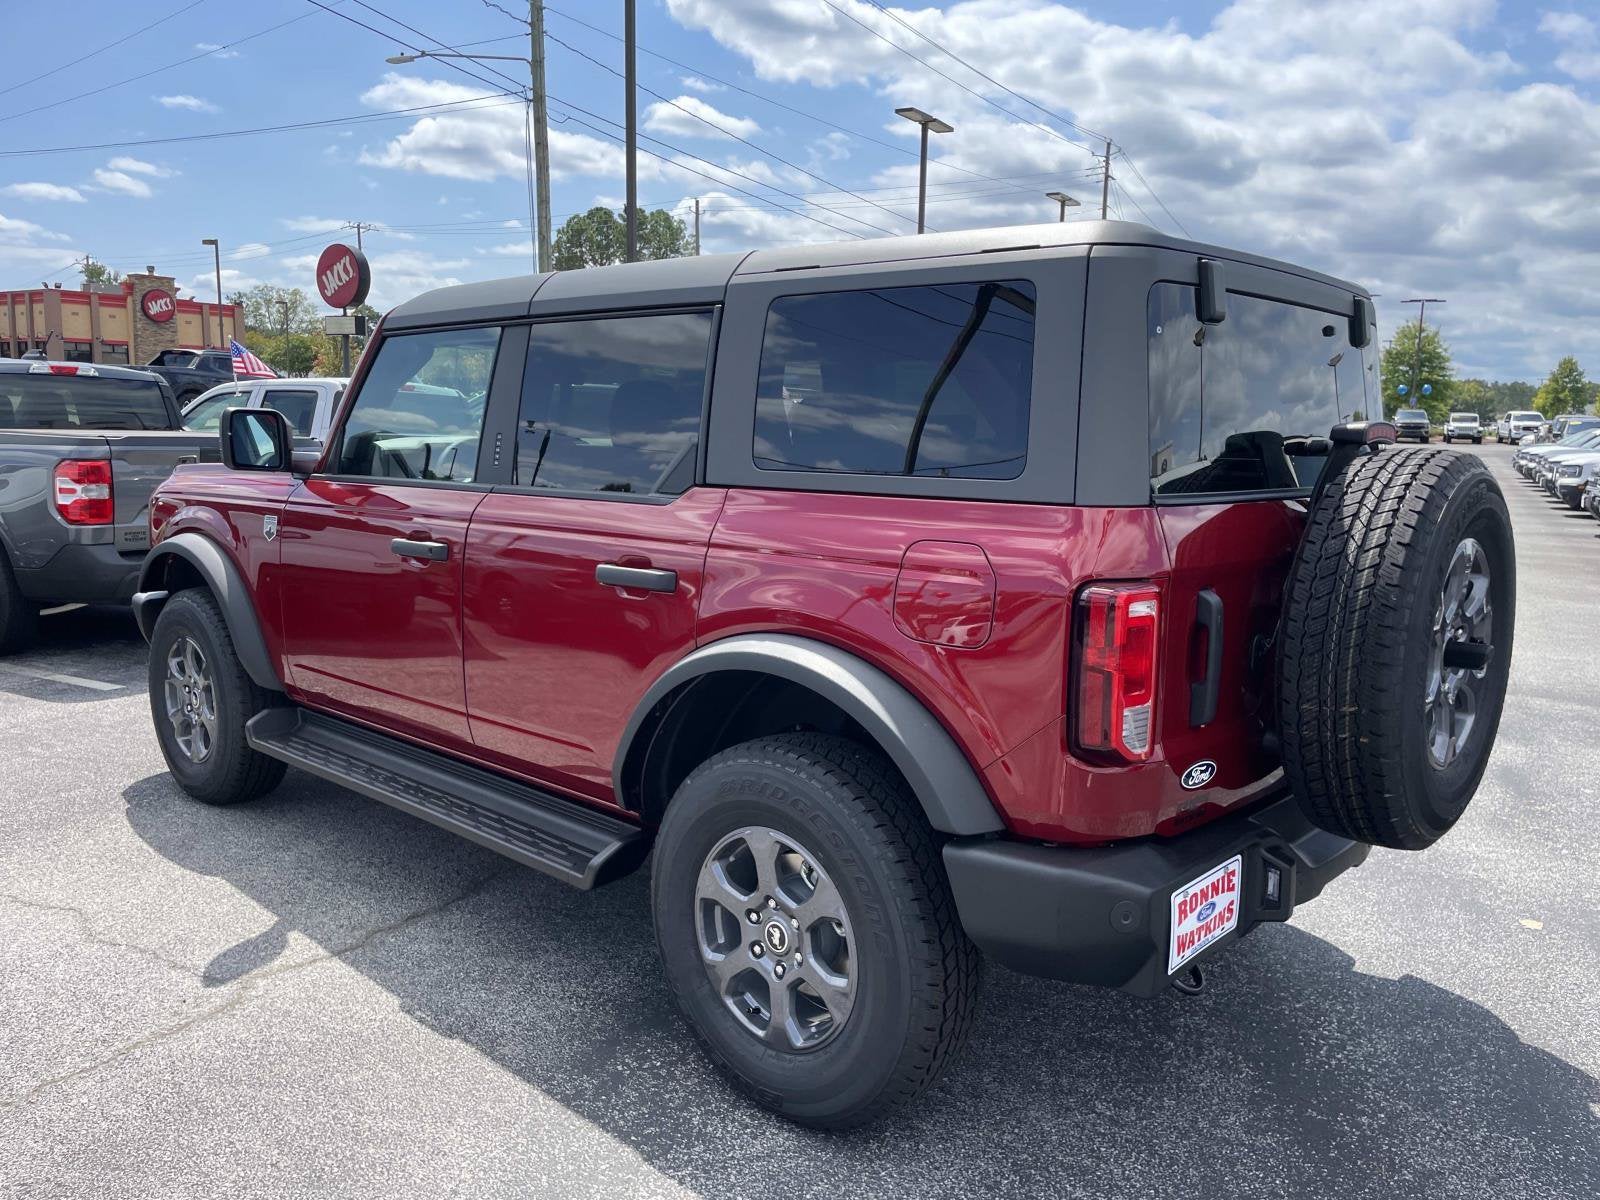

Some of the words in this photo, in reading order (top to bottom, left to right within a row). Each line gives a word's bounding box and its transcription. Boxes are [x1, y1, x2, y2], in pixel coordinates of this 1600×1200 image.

[1188, 765, 1212, 786] Ford
[1177, 869, 1236, 927] RONNIE
[1176, 899, 1235, 957] WATKINS
